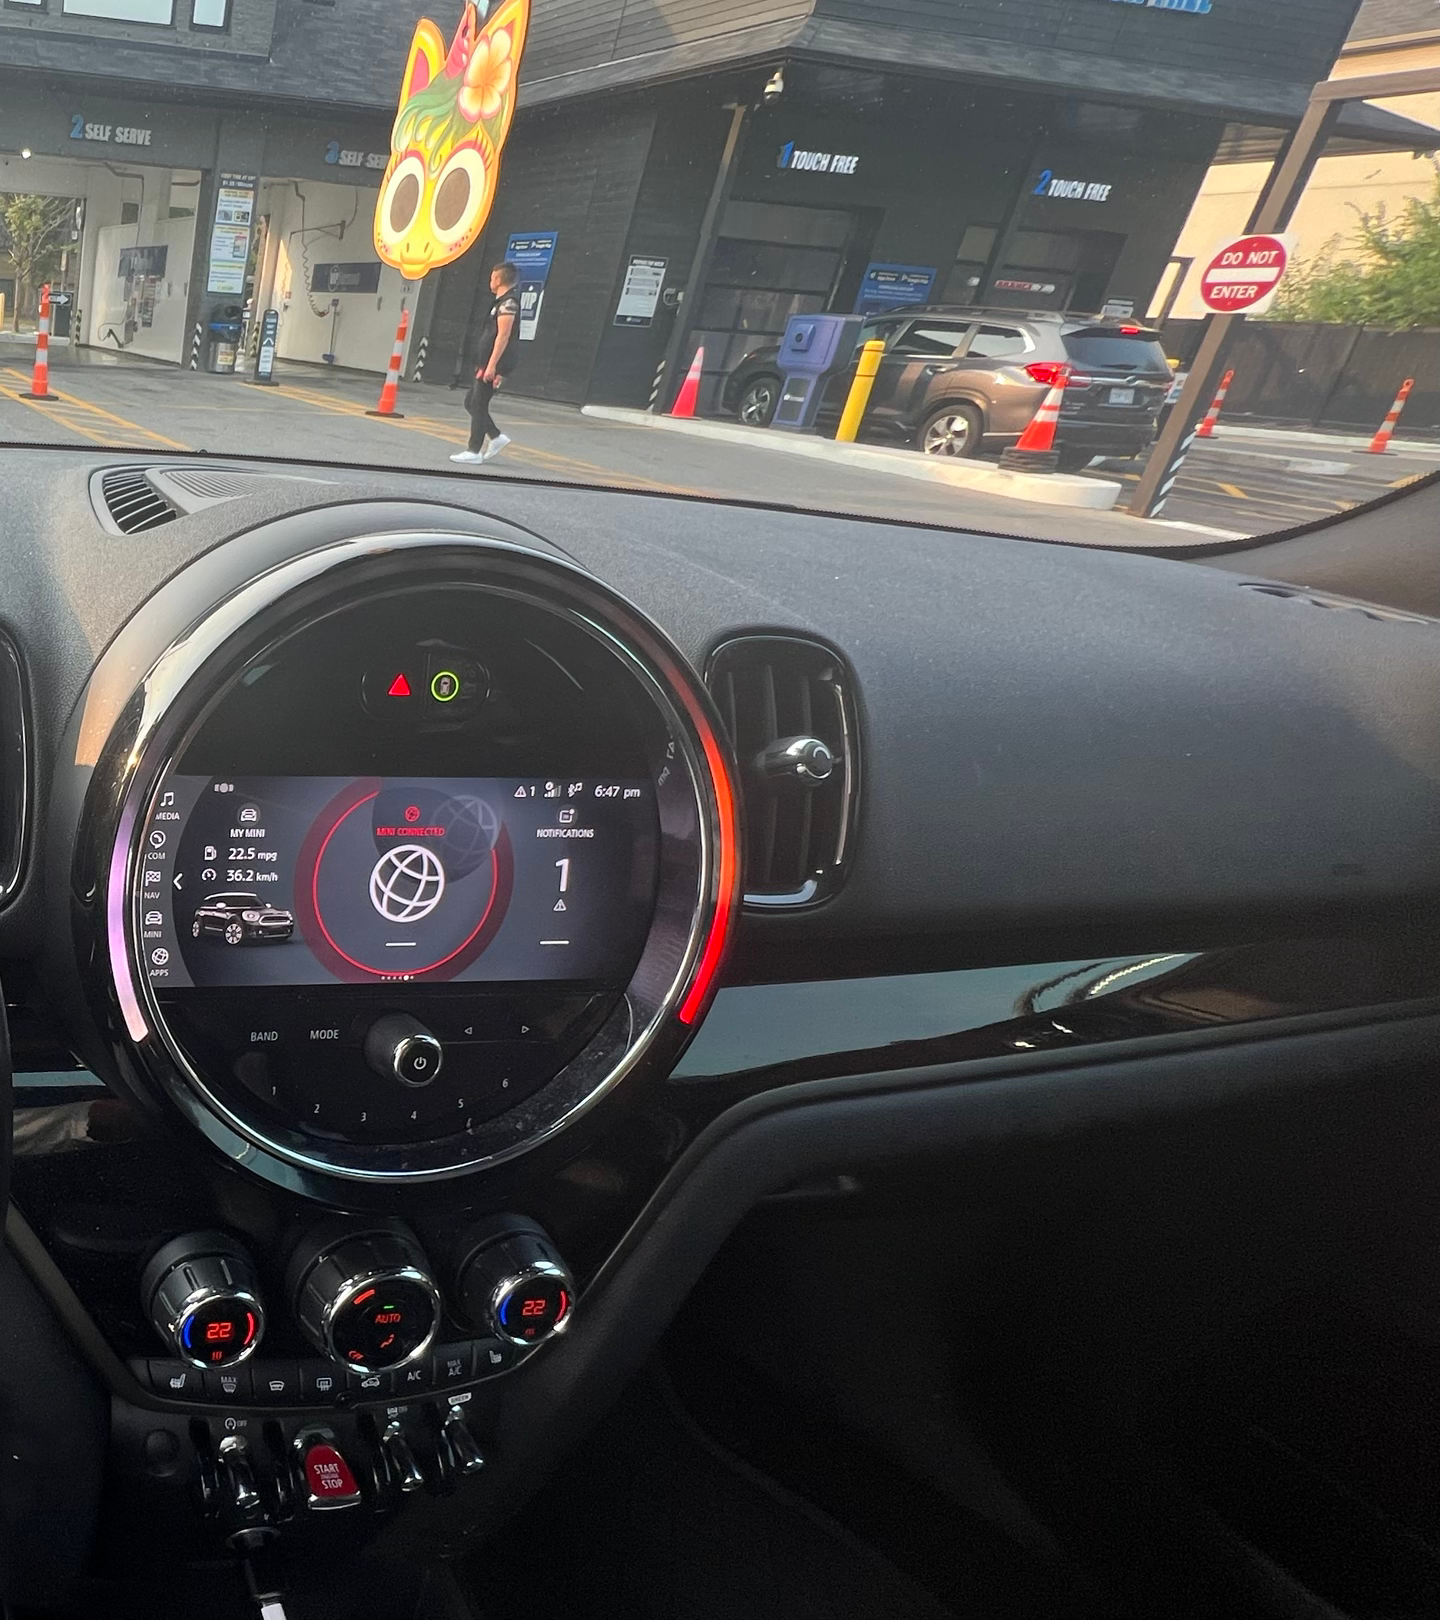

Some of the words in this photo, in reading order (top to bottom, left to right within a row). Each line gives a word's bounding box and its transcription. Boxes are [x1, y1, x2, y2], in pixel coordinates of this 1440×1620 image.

[70, 115, 84, 139] 2
[84, 123, 112, 142] SELF
[114, 126, 152, 146] SERVE
[339, 150, 364, 167] SELF
[778, 141, 795, 168] 1
[791, 150, 829, 172] TOUCH
[830, 154, 859, 175] FREE
[1032, 170, 1053, 196] 2
[1048, 179, 1084, 199] TOUCH
[1083, 182, 1112, 202] FREE
[1220, 251, 1243, 266] DO
[1246, 250, 1279, 265] NOT
[1210, 285, 1258, 300] ENTER
[529, 786, 536, 797] 1
[594, 786, 620, 798] 6:47
[623, 788, 640, 799] pm
[155, 812, 180, 821] MEDIA
[230, 829, 244, 838] MY
[245, 829, 266, 838] MINI
[376, 827, 396, 836] MINI
[397, 827, 445, 837] CONNECTED
[536, 828, 594, 838] NOTIFICATIONS
[147, 852, 166, 860] COM
[228, 848, 255, 860] 22.5
[257, 851, 277, 862] mpg
[226, 869, 254, 882] 36.2
[256, 872, 278, 883] km/h
[555, 858, 570, 892] 1
[144, 891, 160, 899] NAV
[144, 930, 162, 938] MINI
[149, 968, 169, 977] APPS
[250, 1031, 278, 1042] BAND
[310, 1029, 339, 1040] MODE
[502, 1078, 508, 1088] 6
[271, 1086, 276, 1095] 1
[458, 1098, 464, 1108] 5
[313, 1104, 320, 1114] 2
[360, 1112, 367, 1122] 3
[410, 1110, 417, 1120] 4
[522, 1300, 546, 1316] 22
[375, 1314, 401, 1324] AUTO
[207, 1322, 231, 1339] 22
[407, 1370, 421, 1381] A/C
[314, 1463, 340, 1475] START
[321, 1479, 343, 1489] STOP
